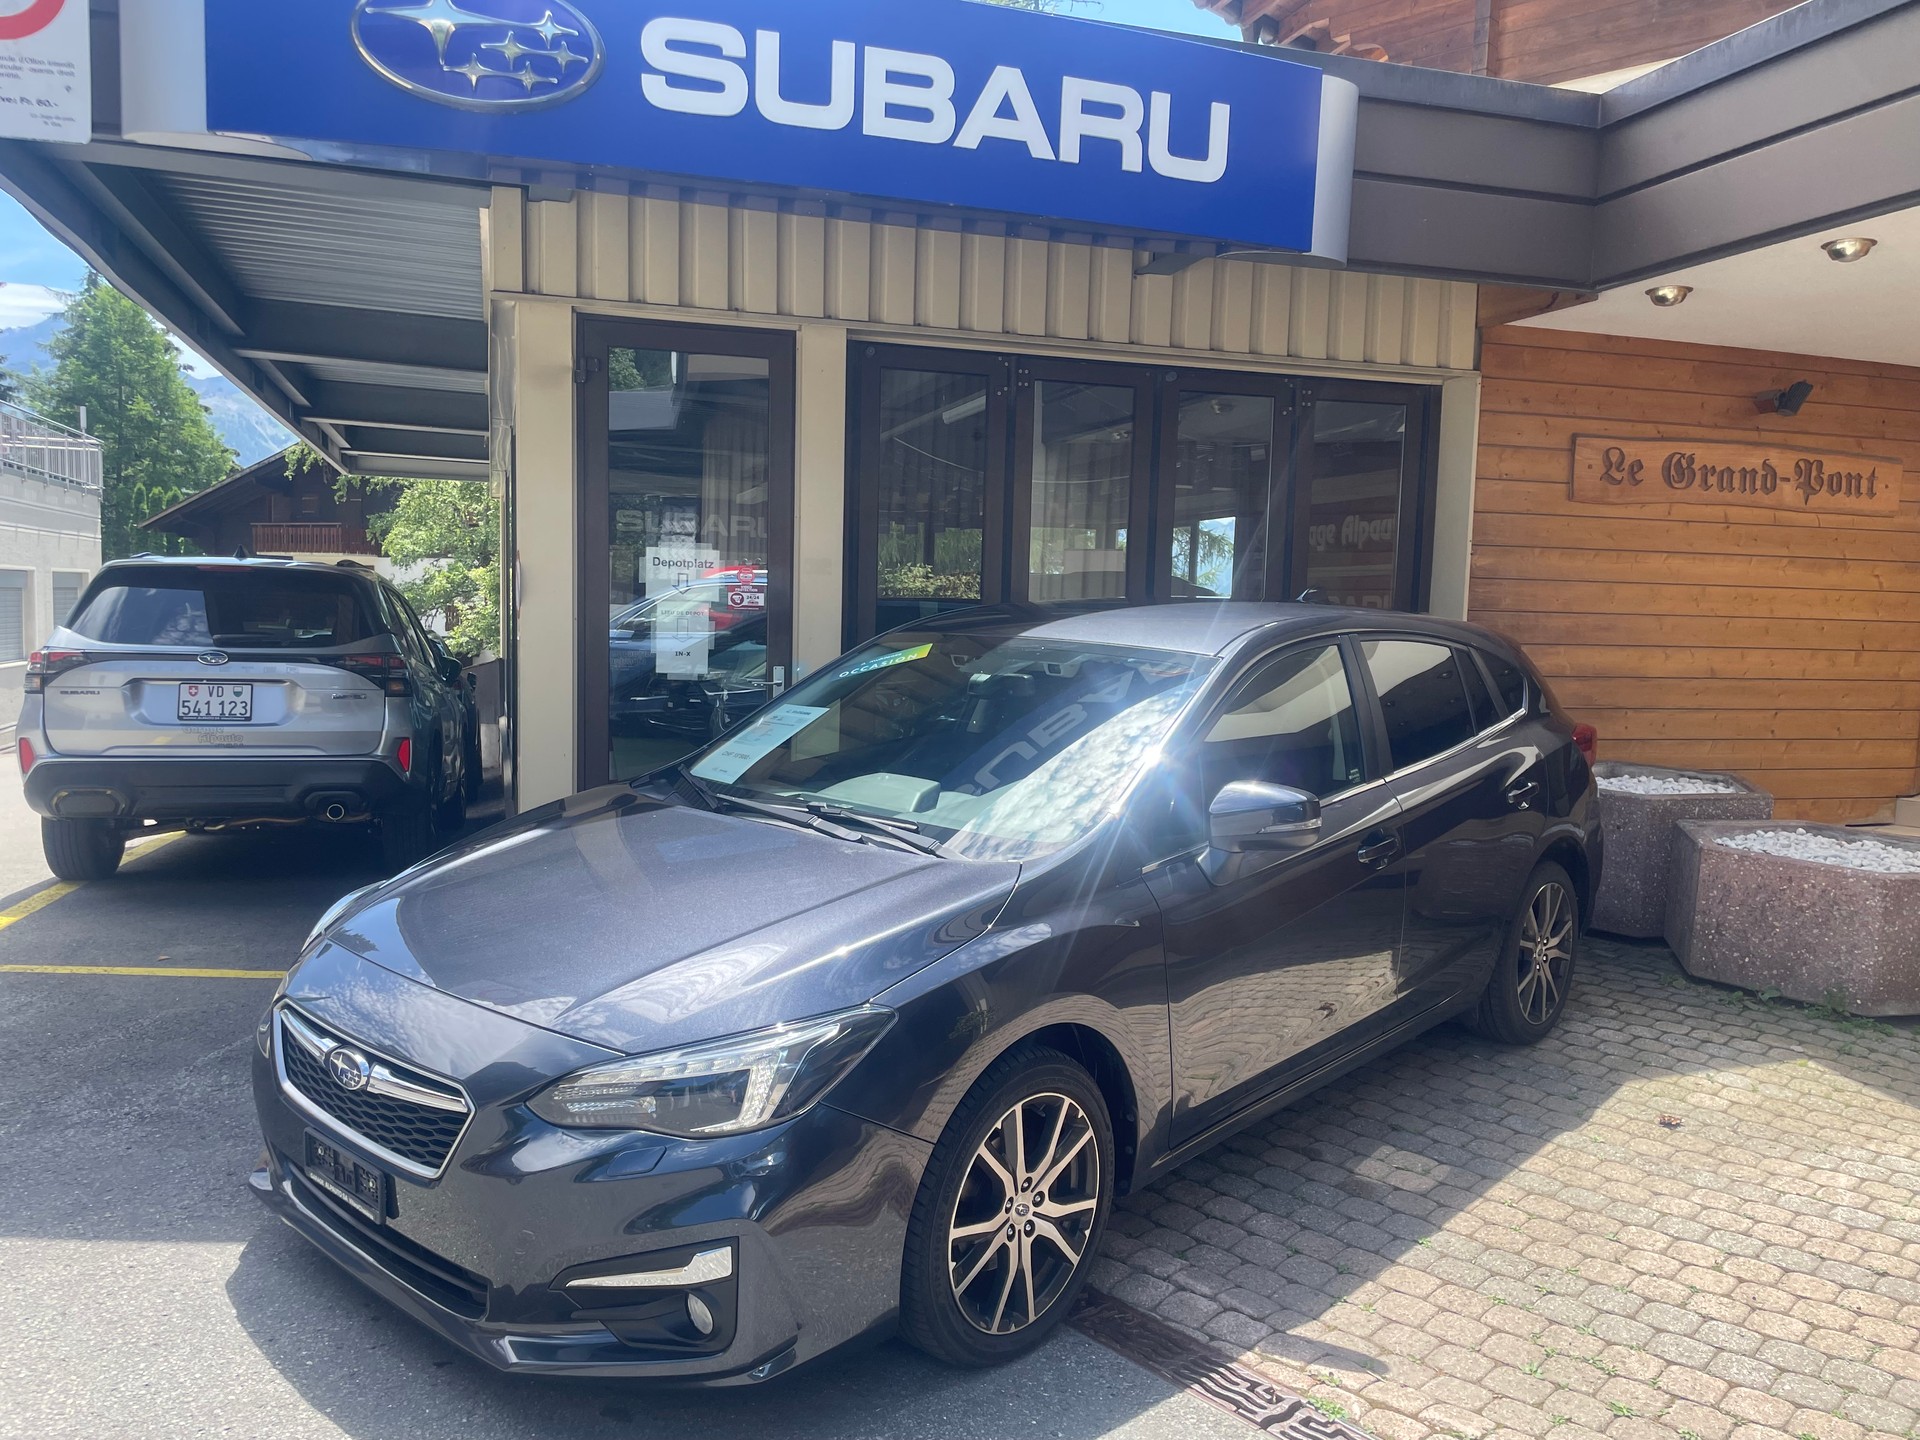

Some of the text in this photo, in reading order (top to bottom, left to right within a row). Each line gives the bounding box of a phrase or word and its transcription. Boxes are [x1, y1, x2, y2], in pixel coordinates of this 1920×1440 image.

[640, 17, 1230, 183] SUBARU
[1600, 446, 1878, 506] Le Grand-Pont
[652, 556, 714, 570] Depotplatz
[838, 653, 918, 678] OCCASION
[208, 685, 224, 698] VD
[182, 700, 248, 716] 541 123
